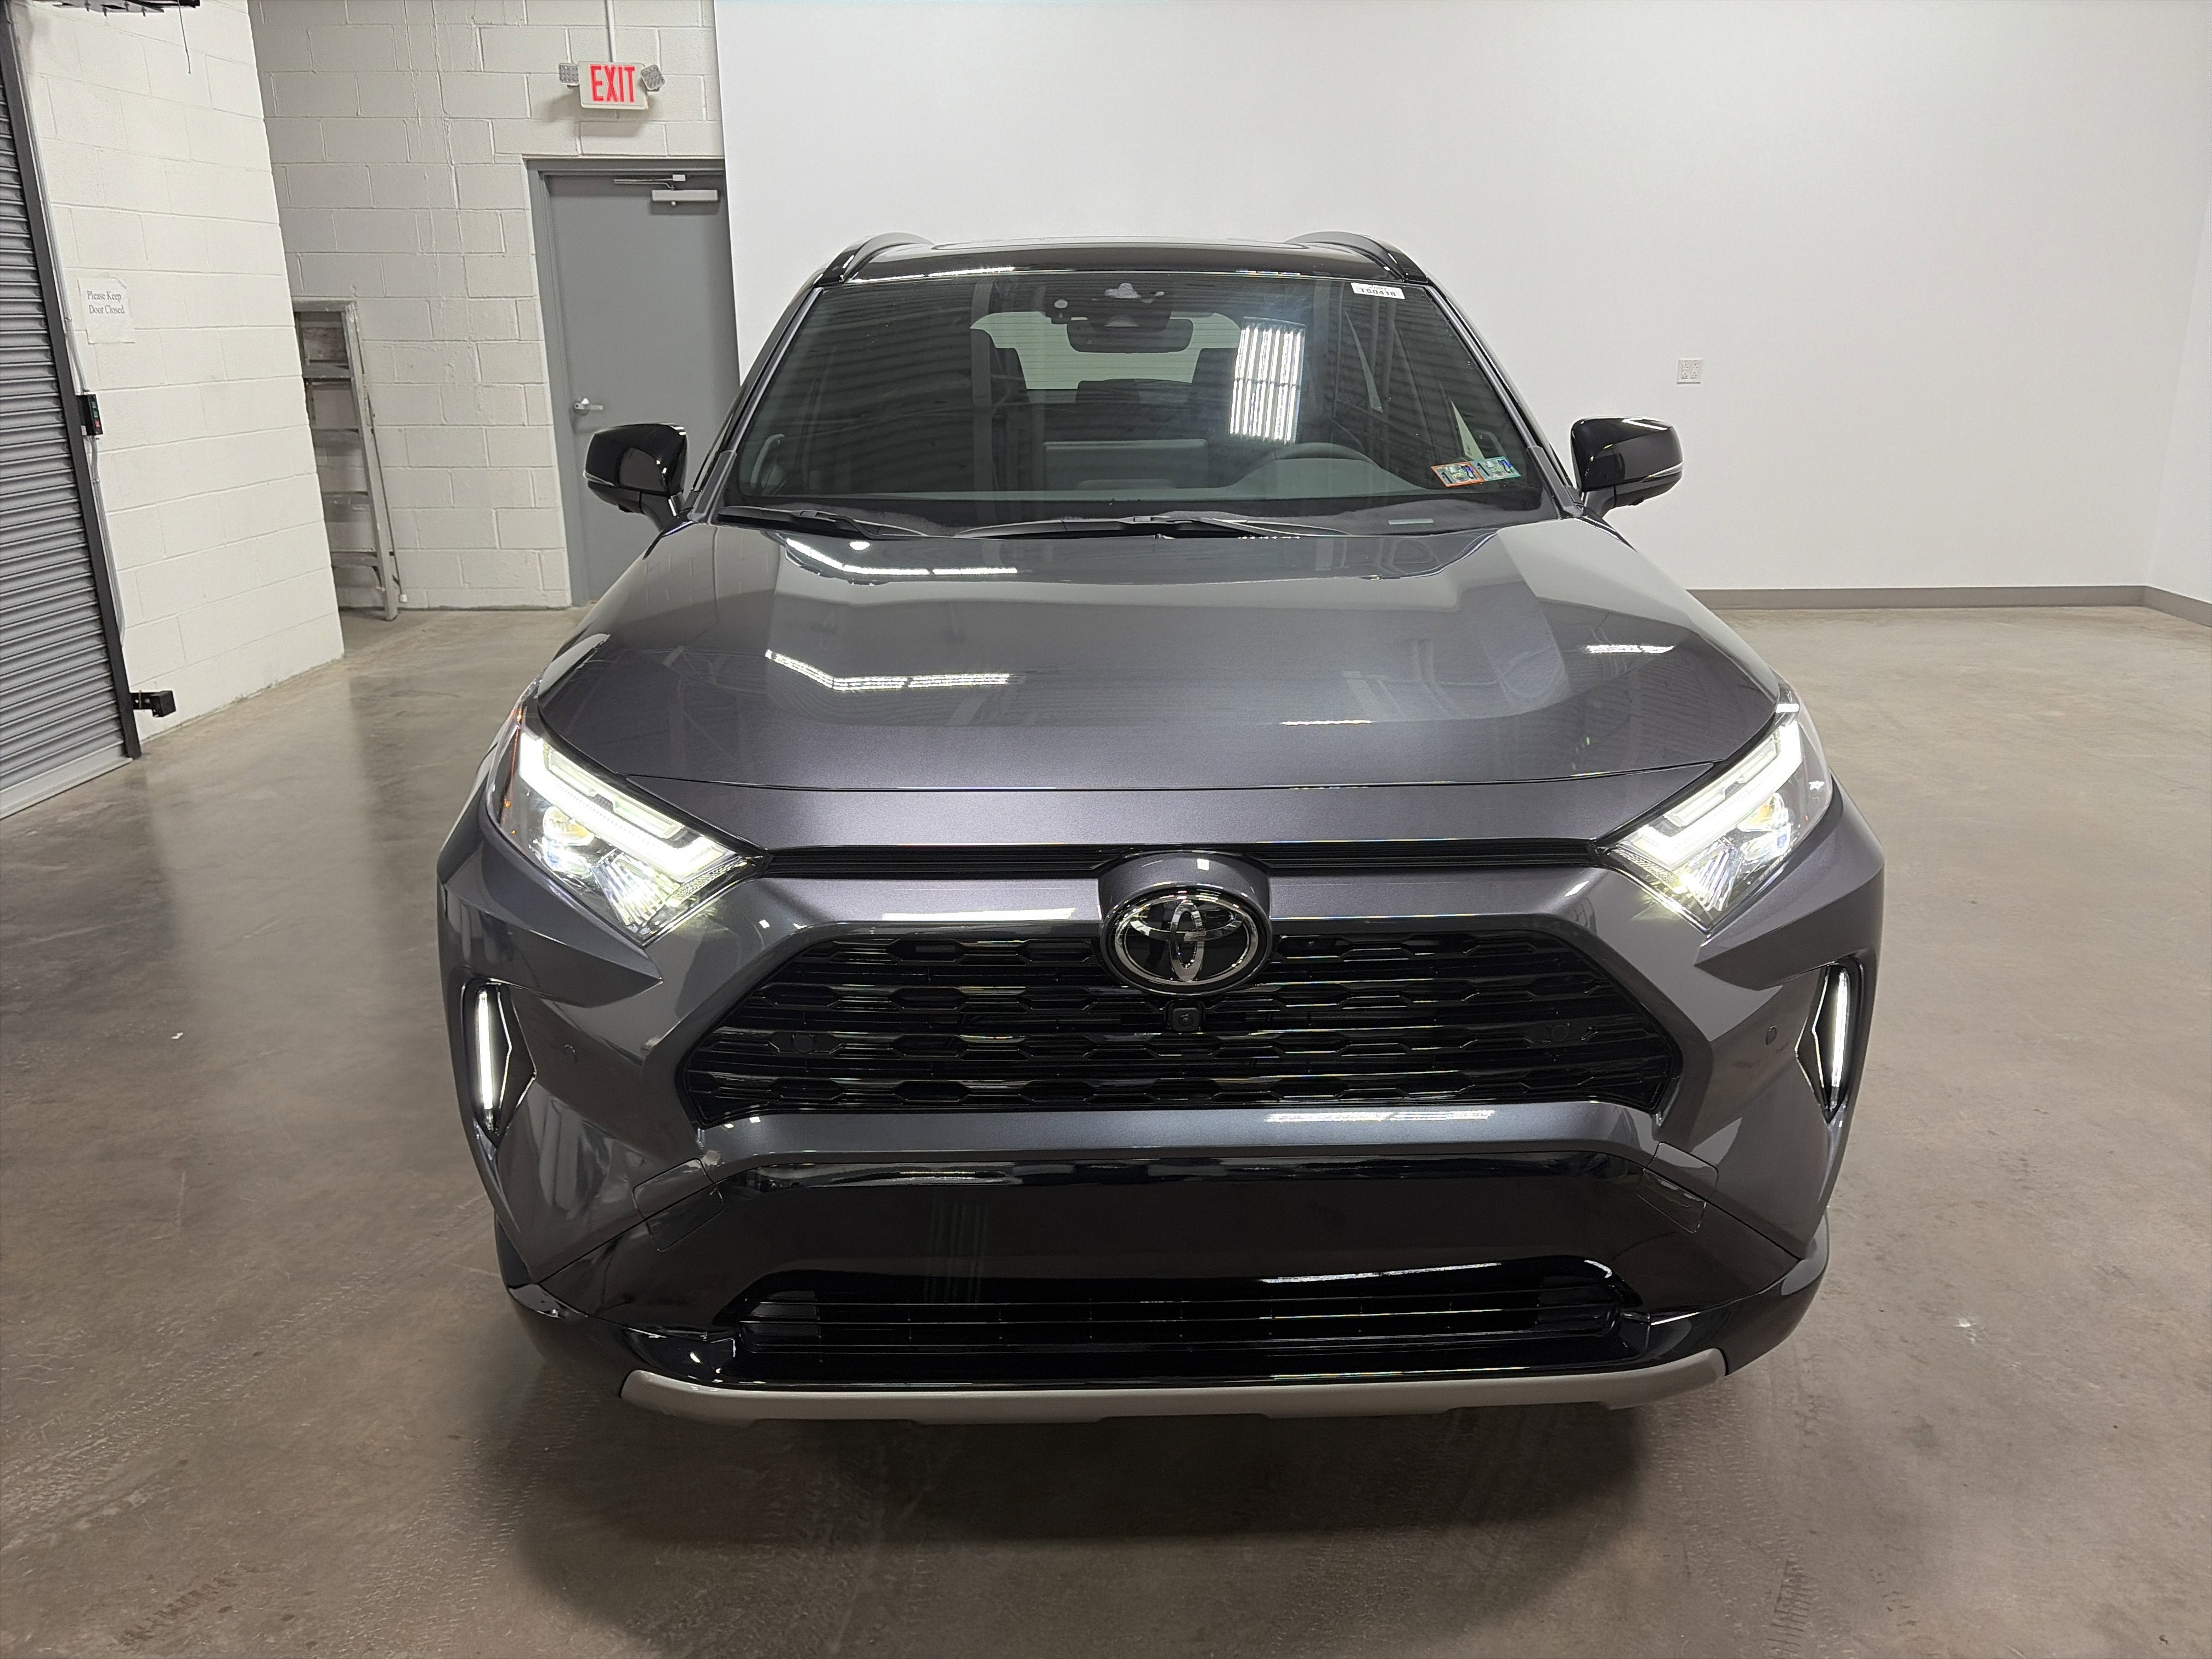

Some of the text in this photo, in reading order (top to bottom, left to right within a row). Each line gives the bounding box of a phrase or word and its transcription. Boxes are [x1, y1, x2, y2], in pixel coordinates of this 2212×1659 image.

[589, 64, 635, 103] EXIT
[87, 290, 121, 303] Please Keep
[89, 304, 125, 314] Door Closed
